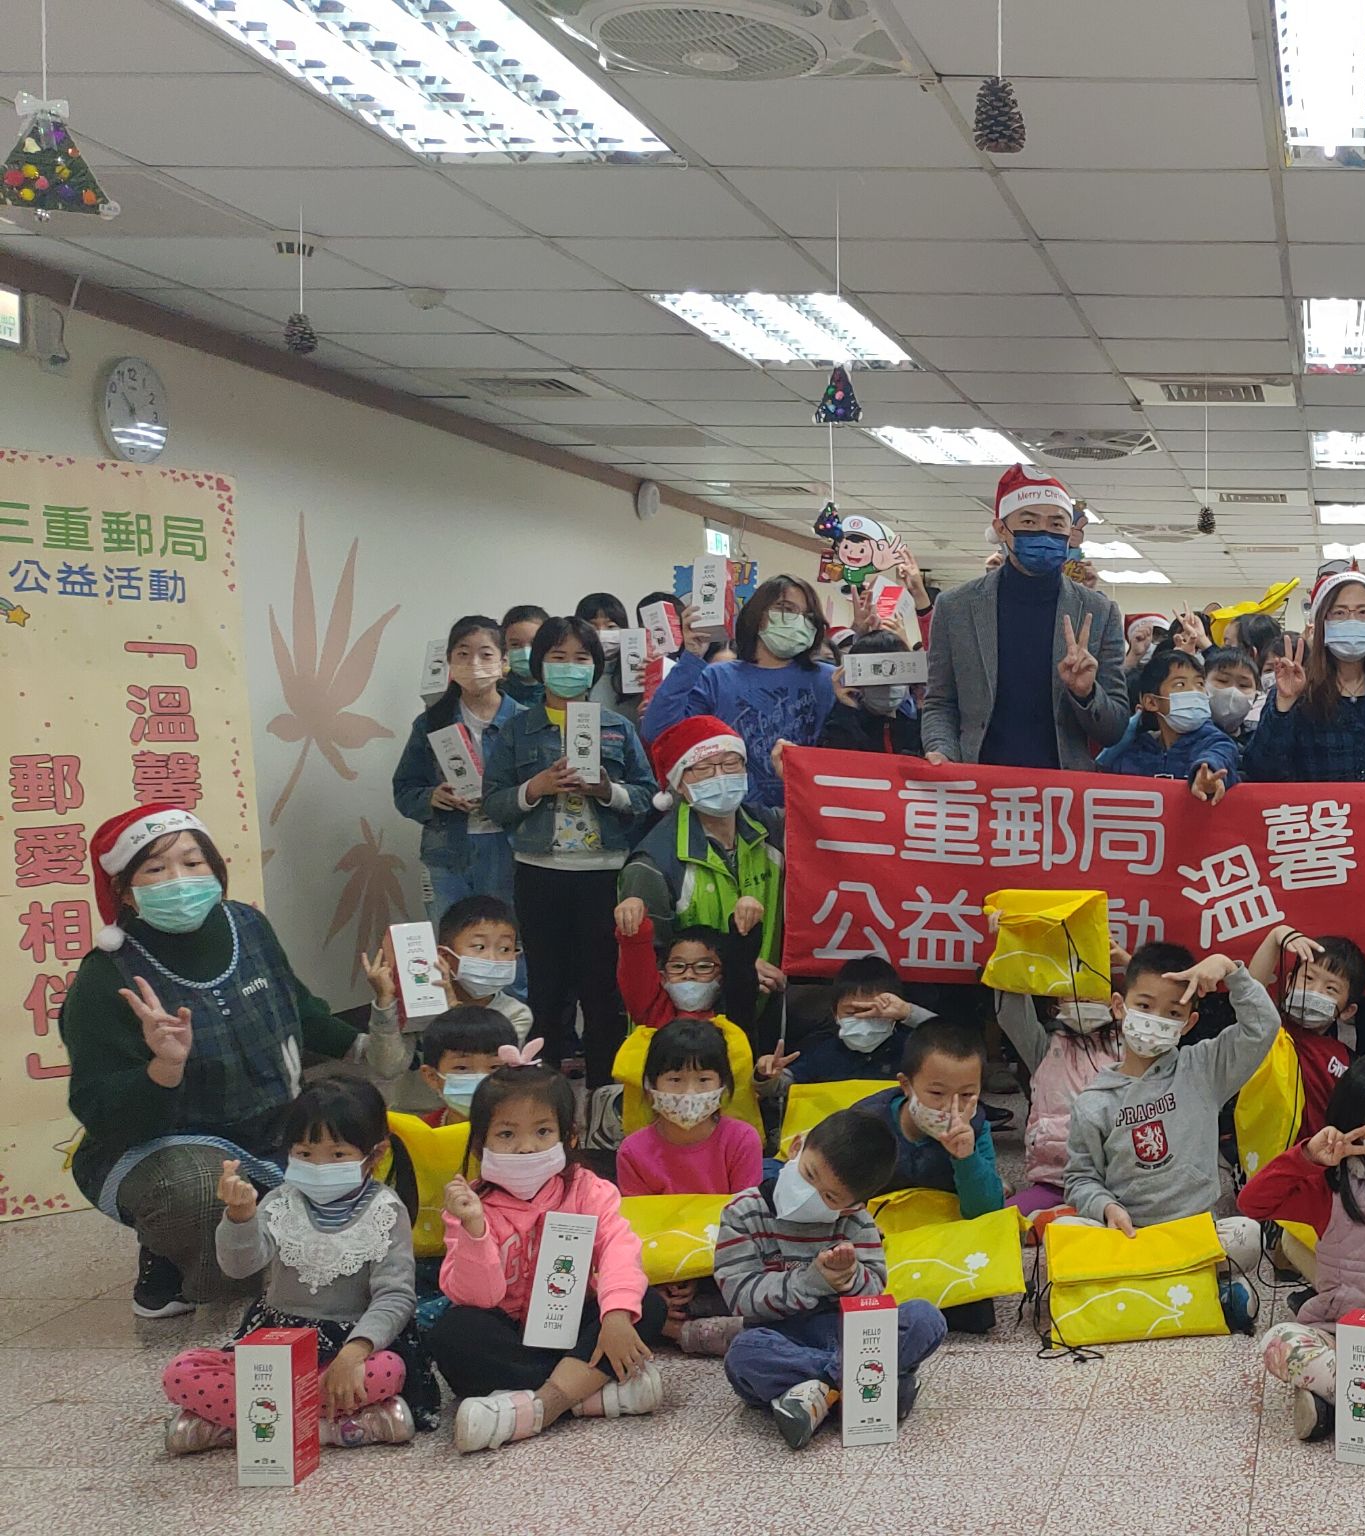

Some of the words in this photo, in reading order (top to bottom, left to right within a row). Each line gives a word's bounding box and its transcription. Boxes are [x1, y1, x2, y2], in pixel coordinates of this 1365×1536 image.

[1017, 491, 1041, 501] Merry
[0, 502, 207, 561] 三重郵局
[9, 560, 186, 603] 公益活動
[813, 774, 1165, 875] 三重郵局
[812, 881, 1165, 971] 公益動
[1115, 1092, 1176, 1127] PRAGUE
[546, 1312, 564, 1321] KITTY
[543, 1321, 562, 1330] HELLO
[863, 1328, 882, 1336] HELLO
[862, 1336, 881, 1345] KITTY
[254, 1364, 273, 1372] HELLO
[254, 1373, 273, 1381] KITTY
